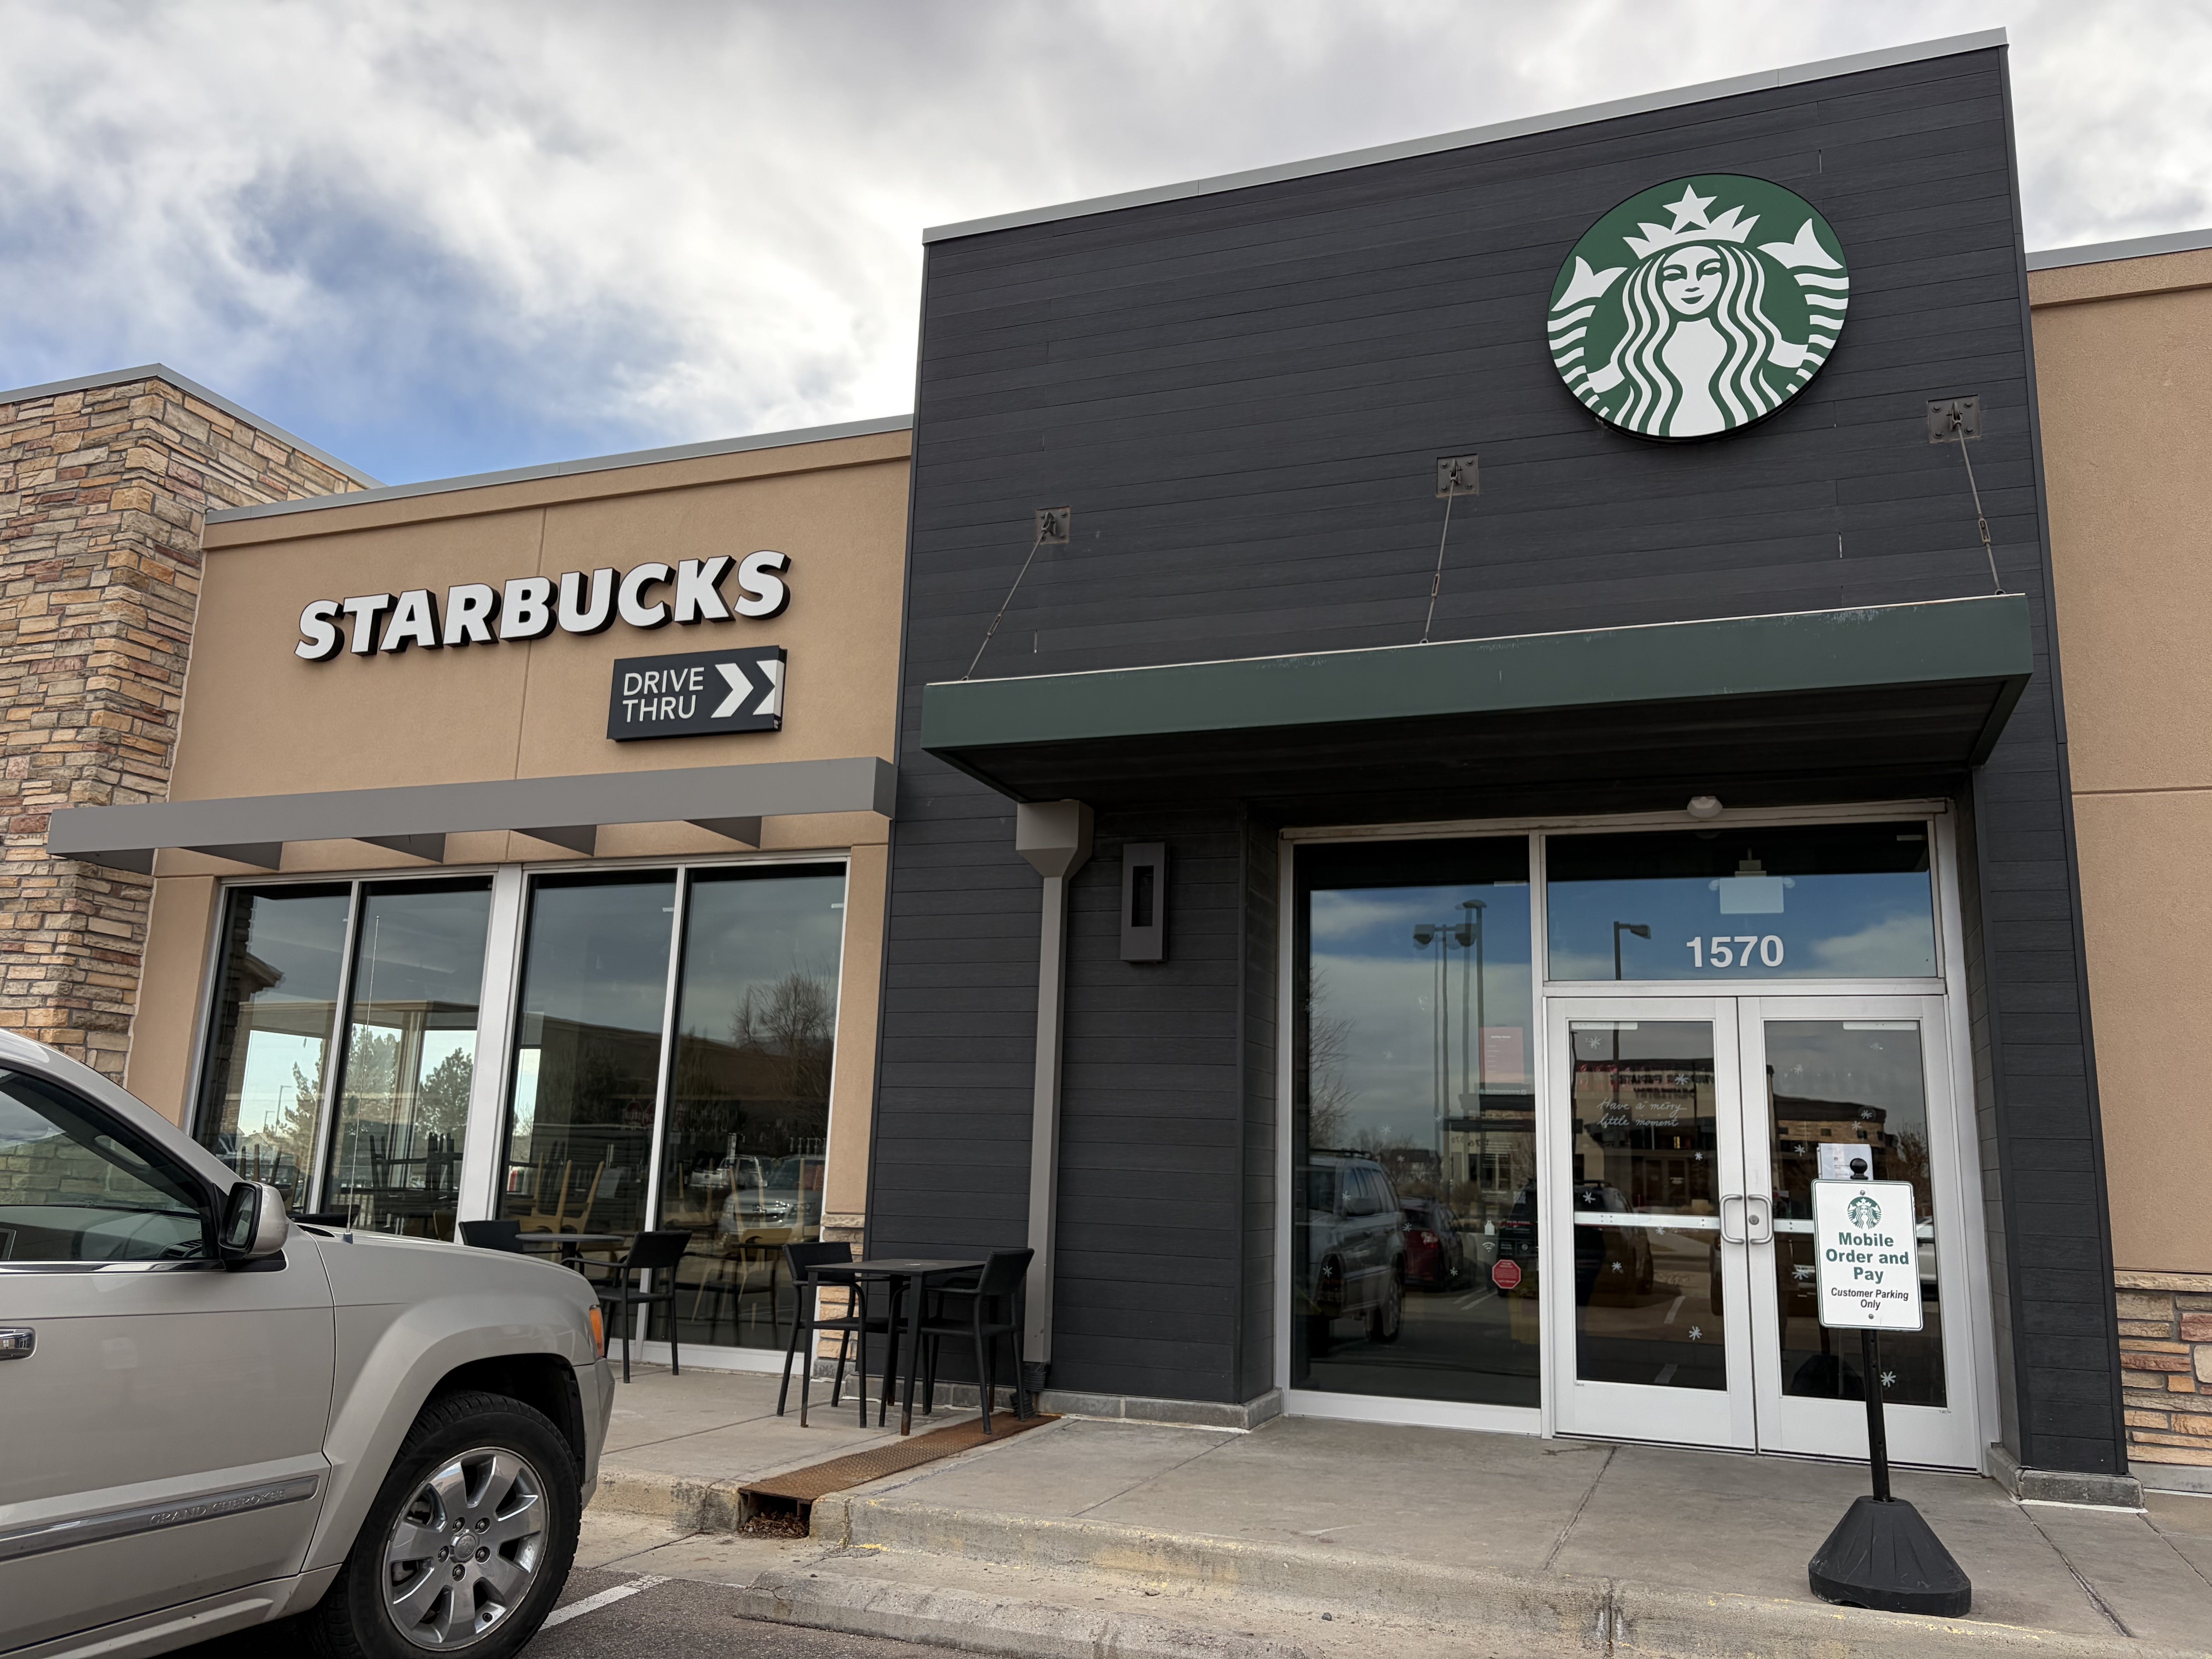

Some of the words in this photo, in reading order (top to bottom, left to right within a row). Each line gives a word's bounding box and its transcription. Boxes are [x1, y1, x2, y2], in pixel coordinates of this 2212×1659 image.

[294, 549, 790, 662] STARBUCKS
[623, 667, 705, 696] DRIVE
[622, 694, 697, 723] THRU
[1686, 935, 1784, 967] 1570
[1597, 1098, 1630, 1109] Have
[1650, 1102, 1687, 1118] merry
[1597, 1113, 1630, 1126] little
[1635, 1116, 1679, 1127] moment
[1839, 1232, 1894, 1247] Mobile
[1826, 1248, 1873, 1263] Order
[1879, 1251, 1909, 1265] and
[1853, 1266, 1884, 1284] Pay
[1831, 1287, 1873, 1298] Customer
[1875, 1289, 1909, 1302] Parking
[1860, 1299, 1881, 1310] Only
[151, 1505, 207, 1524] GRAND
[213, 1489, 286, 1512] CHEROKEE
